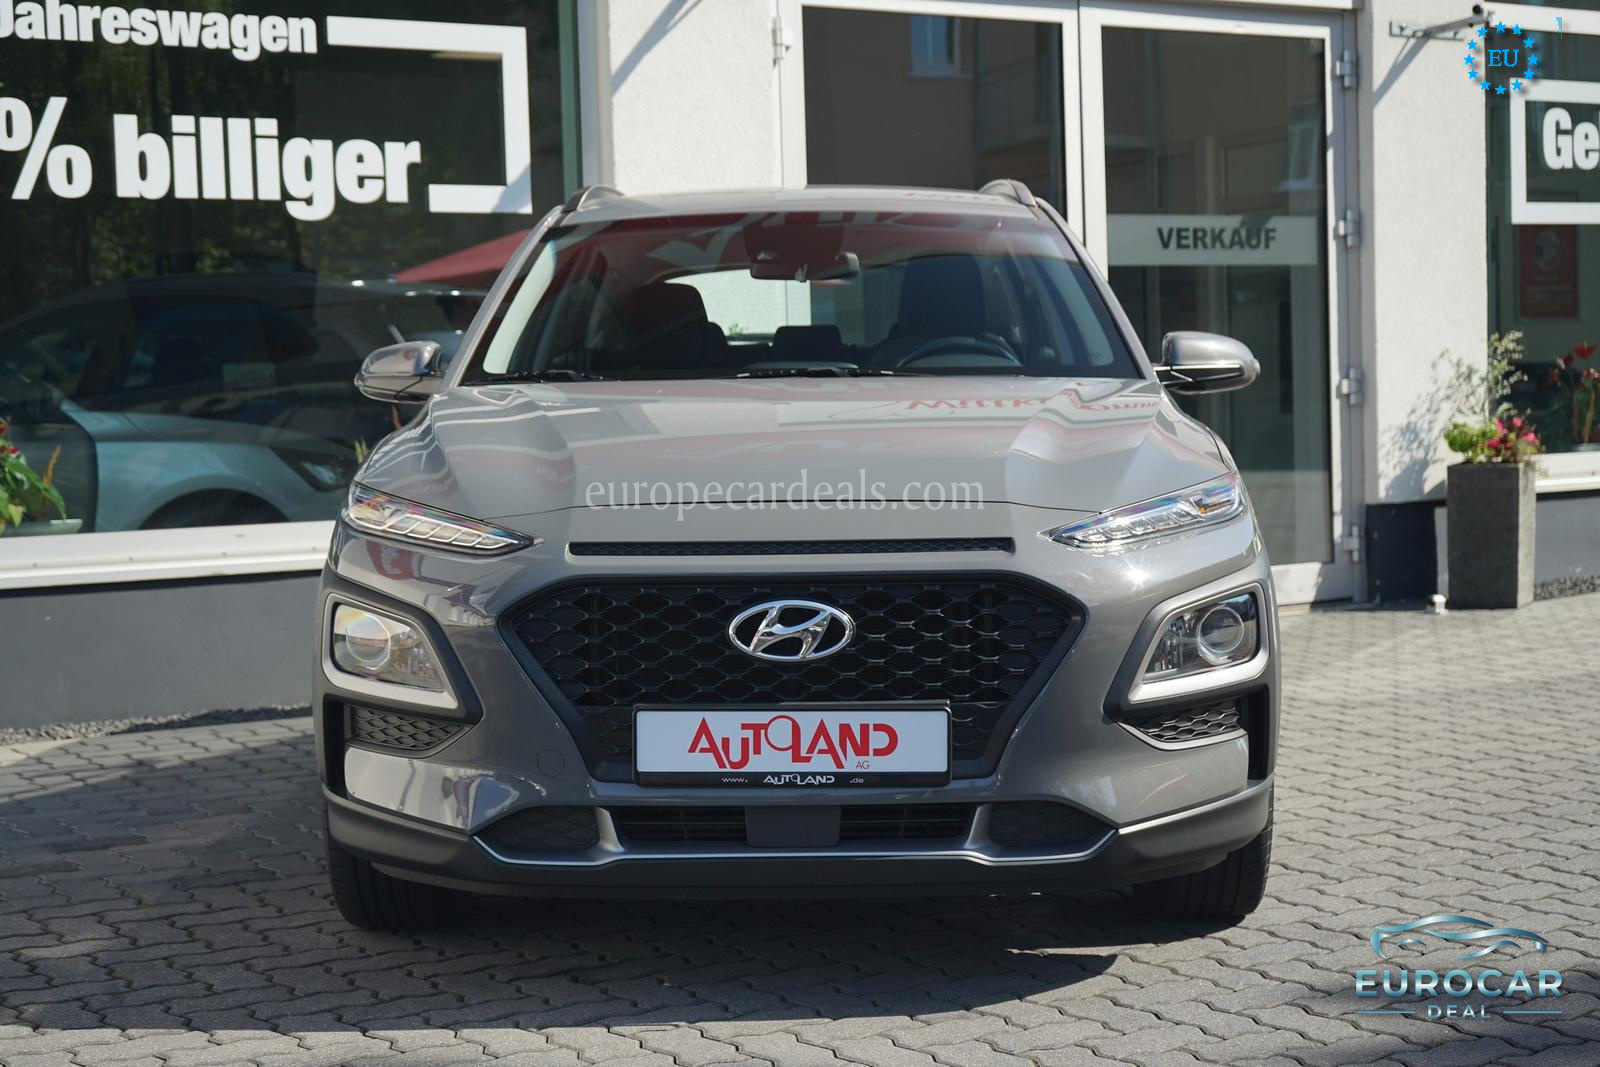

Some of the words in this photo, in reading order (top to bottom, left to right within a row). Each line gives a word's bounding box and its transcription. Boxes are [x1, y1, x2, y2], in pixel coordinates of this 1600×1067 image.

[0, 0, 317, 61] Jahreswagen
[0, 96, 93, 200] %
[113, 113, 422, 221] billiger
[1543, 106, 1600, 171] Ge
[1157, 226, 1278, 250] VERKAUF
[855, 760, 871, 770] AG
